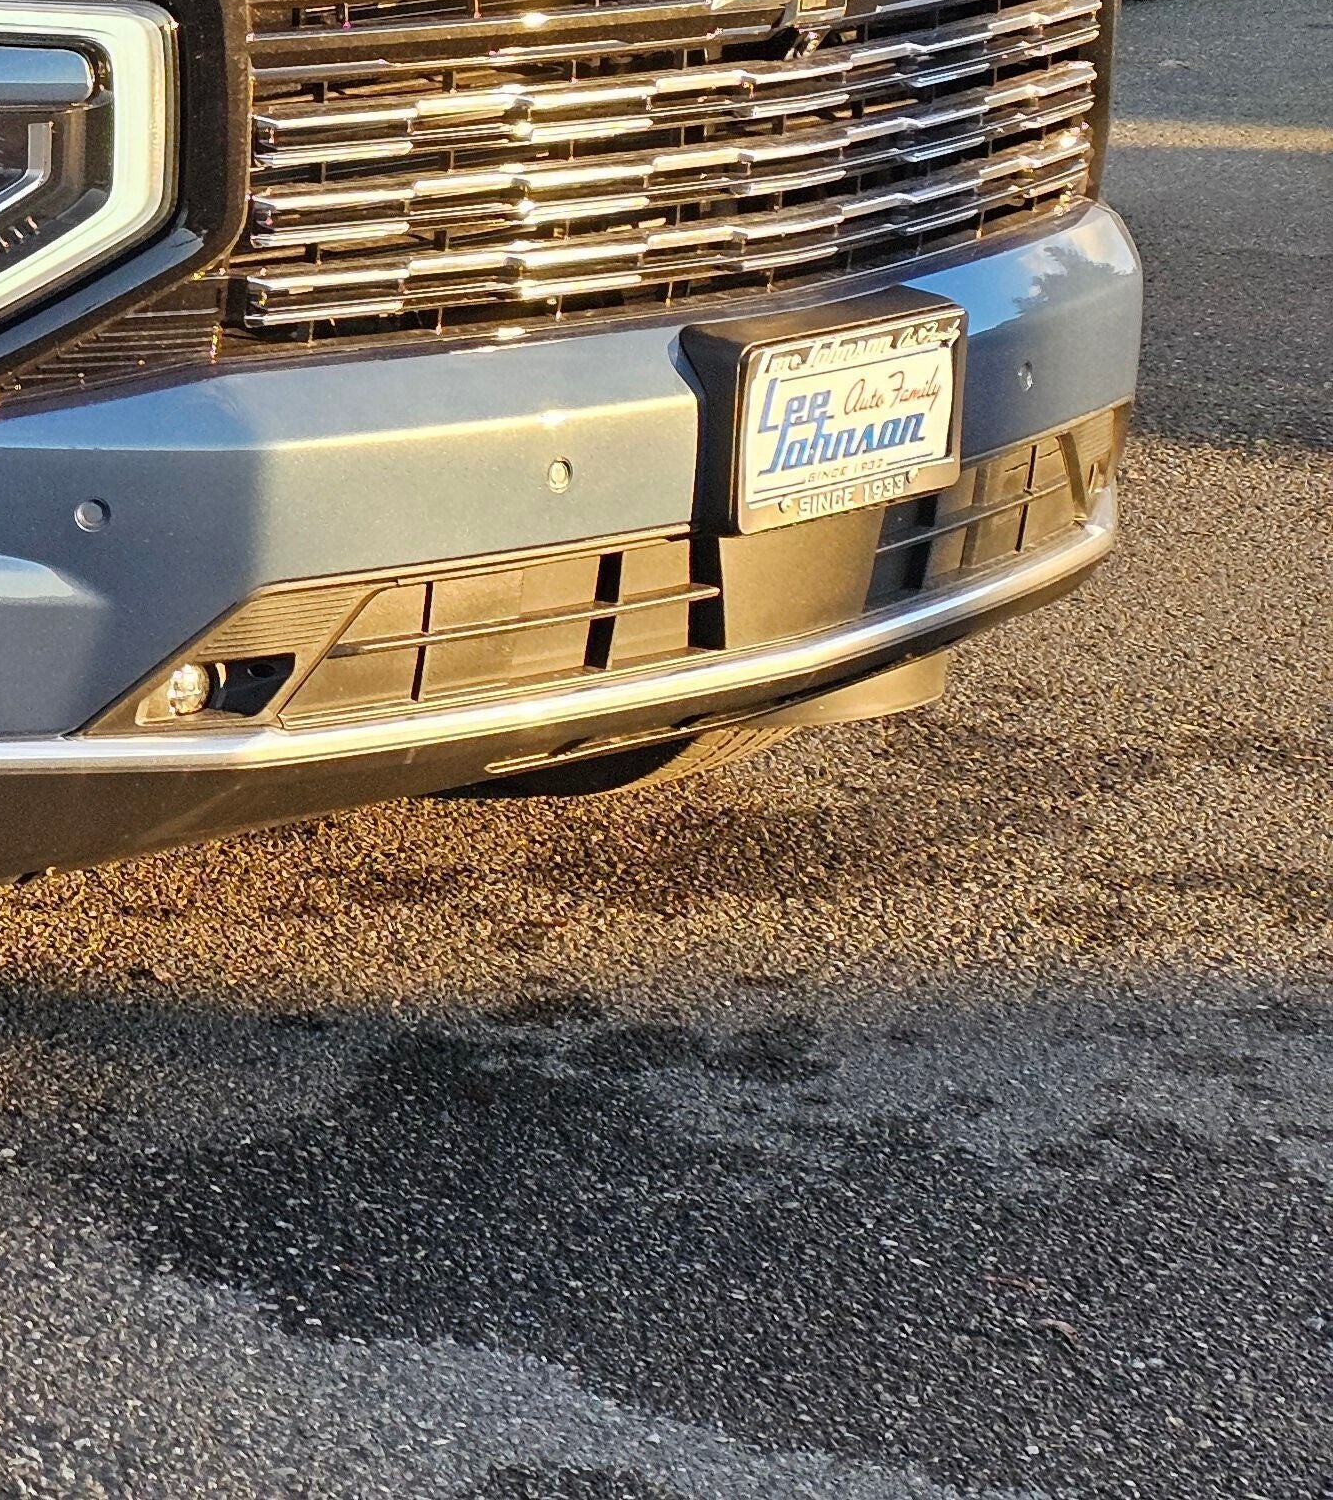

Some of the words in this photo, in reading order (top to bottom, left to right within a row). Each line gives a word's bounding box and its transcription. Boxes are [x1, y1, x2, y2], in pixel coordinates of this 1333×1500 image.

[757, 377, 835, 434] Lee
[843, 378, 885, 416] Auto
[888, 365, 943, 412] Family
[757, 412, 926, 478] Johnson
[797, 485, 856, 518] SINCE
[862, 474, 906, 504] 1933
